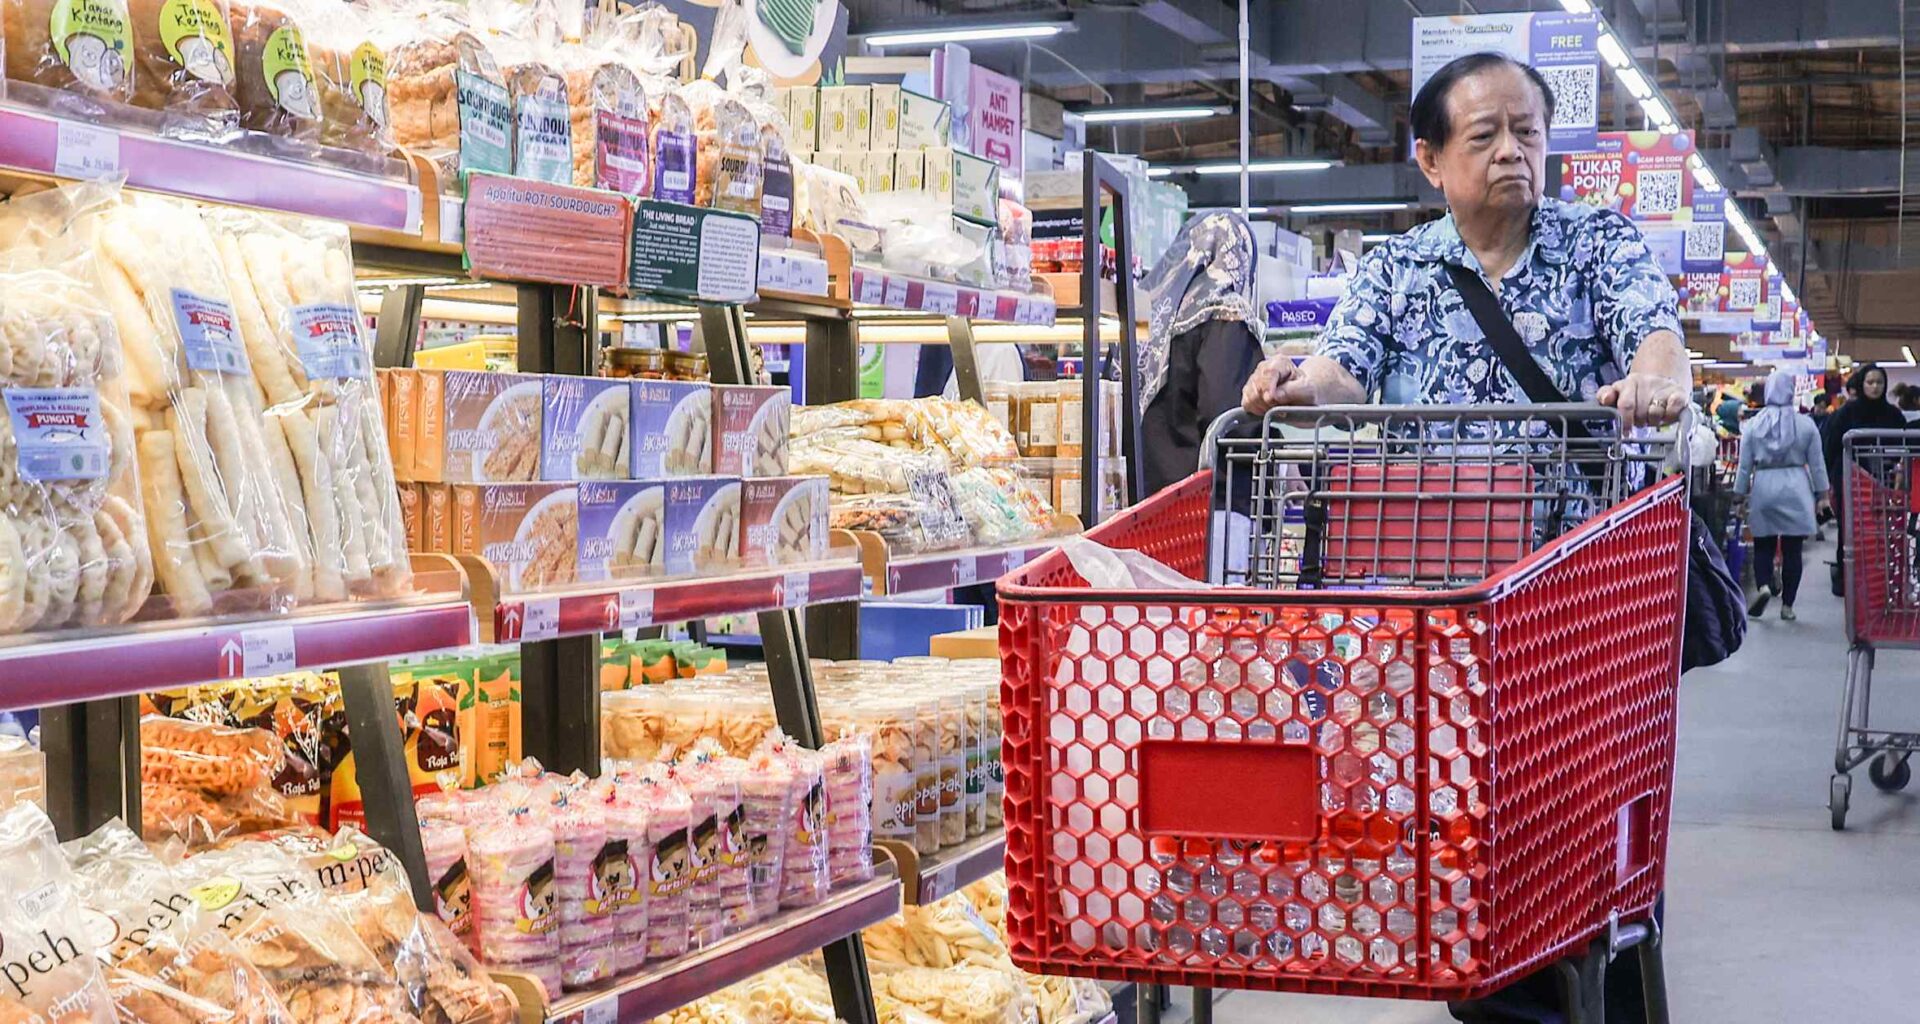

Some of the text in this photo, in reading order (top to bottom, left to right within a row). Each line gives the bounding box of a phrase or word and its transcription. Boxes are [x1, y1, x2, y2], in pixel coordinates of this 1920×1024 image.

[71, 7, 123, 34] Kentang
[1551, 35, 1583, 49] FREE
[989, 91, 1008, 114] ANTI
[982, 110, 1015, 137] MAMPET
[528, 134, 567, 145] VEGAN
[1571, 160, 1622, 175] TUKAR
[1573, 175, 1621, 190] POIN?
[524, 190, 547, 206] ROTI
[549, 195, 617, 217] SOURDOUGH?
[642, 209, 695, 226] THE LIVING BREAD
[1687, 280, 1720, 291] POIN?
[1281, 310, 1316, 322] PASEO
[649, 387, 671, 401] ASLI
[731, 392, 755, 405] ASLI
[35, 414, 77, 425] PUNGUT
[498, 490, 527, 506] ASLI
[755, 484, 776, 499] ASLI
[426, 754, 449, 769] Raja
[281, 780, 306, 796] Raja
